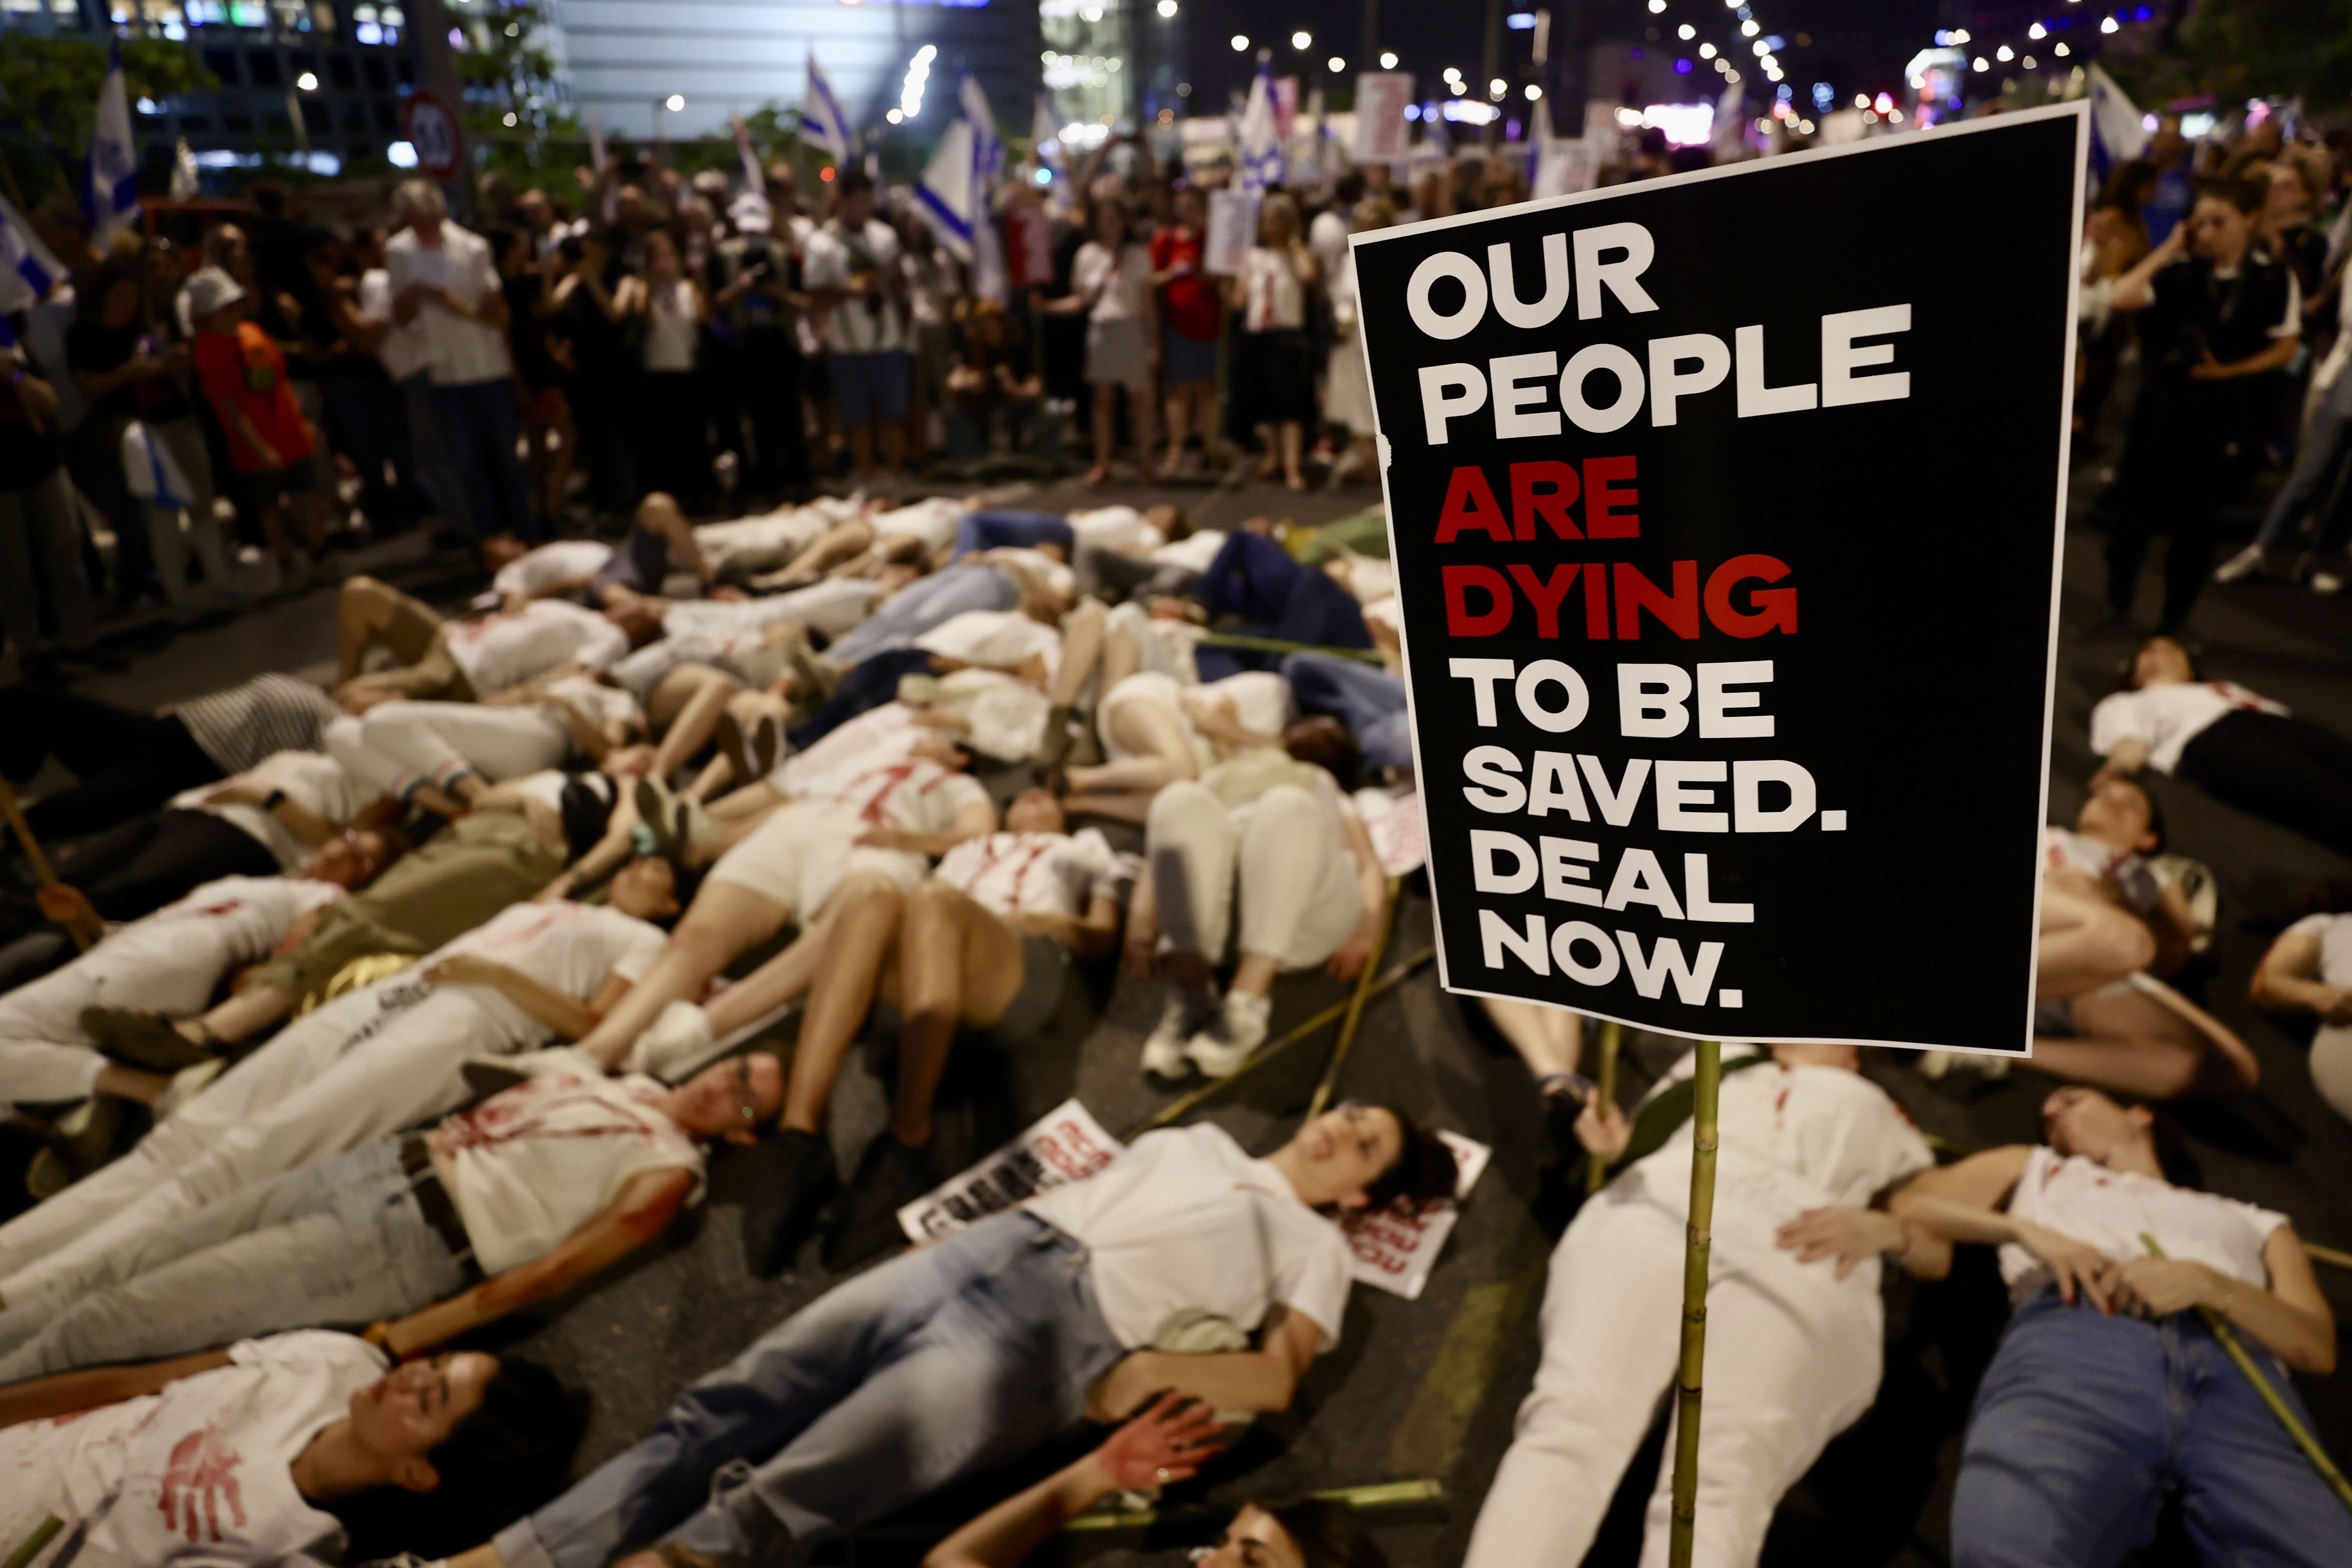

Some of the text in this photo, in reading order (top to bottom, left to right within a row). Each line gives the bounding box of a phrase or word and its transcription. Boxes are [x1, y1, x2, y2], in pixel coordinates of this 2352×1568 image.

[1406, 222, 1660, 340] OUR
[1418, 303, 1912, 445] PEOPLE
[1434, 455, 1640, 544] ARE
[1442, 554, 1798, 640] DYING
[1449, 658, 1775, 738] TO BE
[1462, 745, 1847, 833] SAVED.
[1470, 829, 1755, 923] DEAL
[1478, 909, 1743, 1008] NOW.
